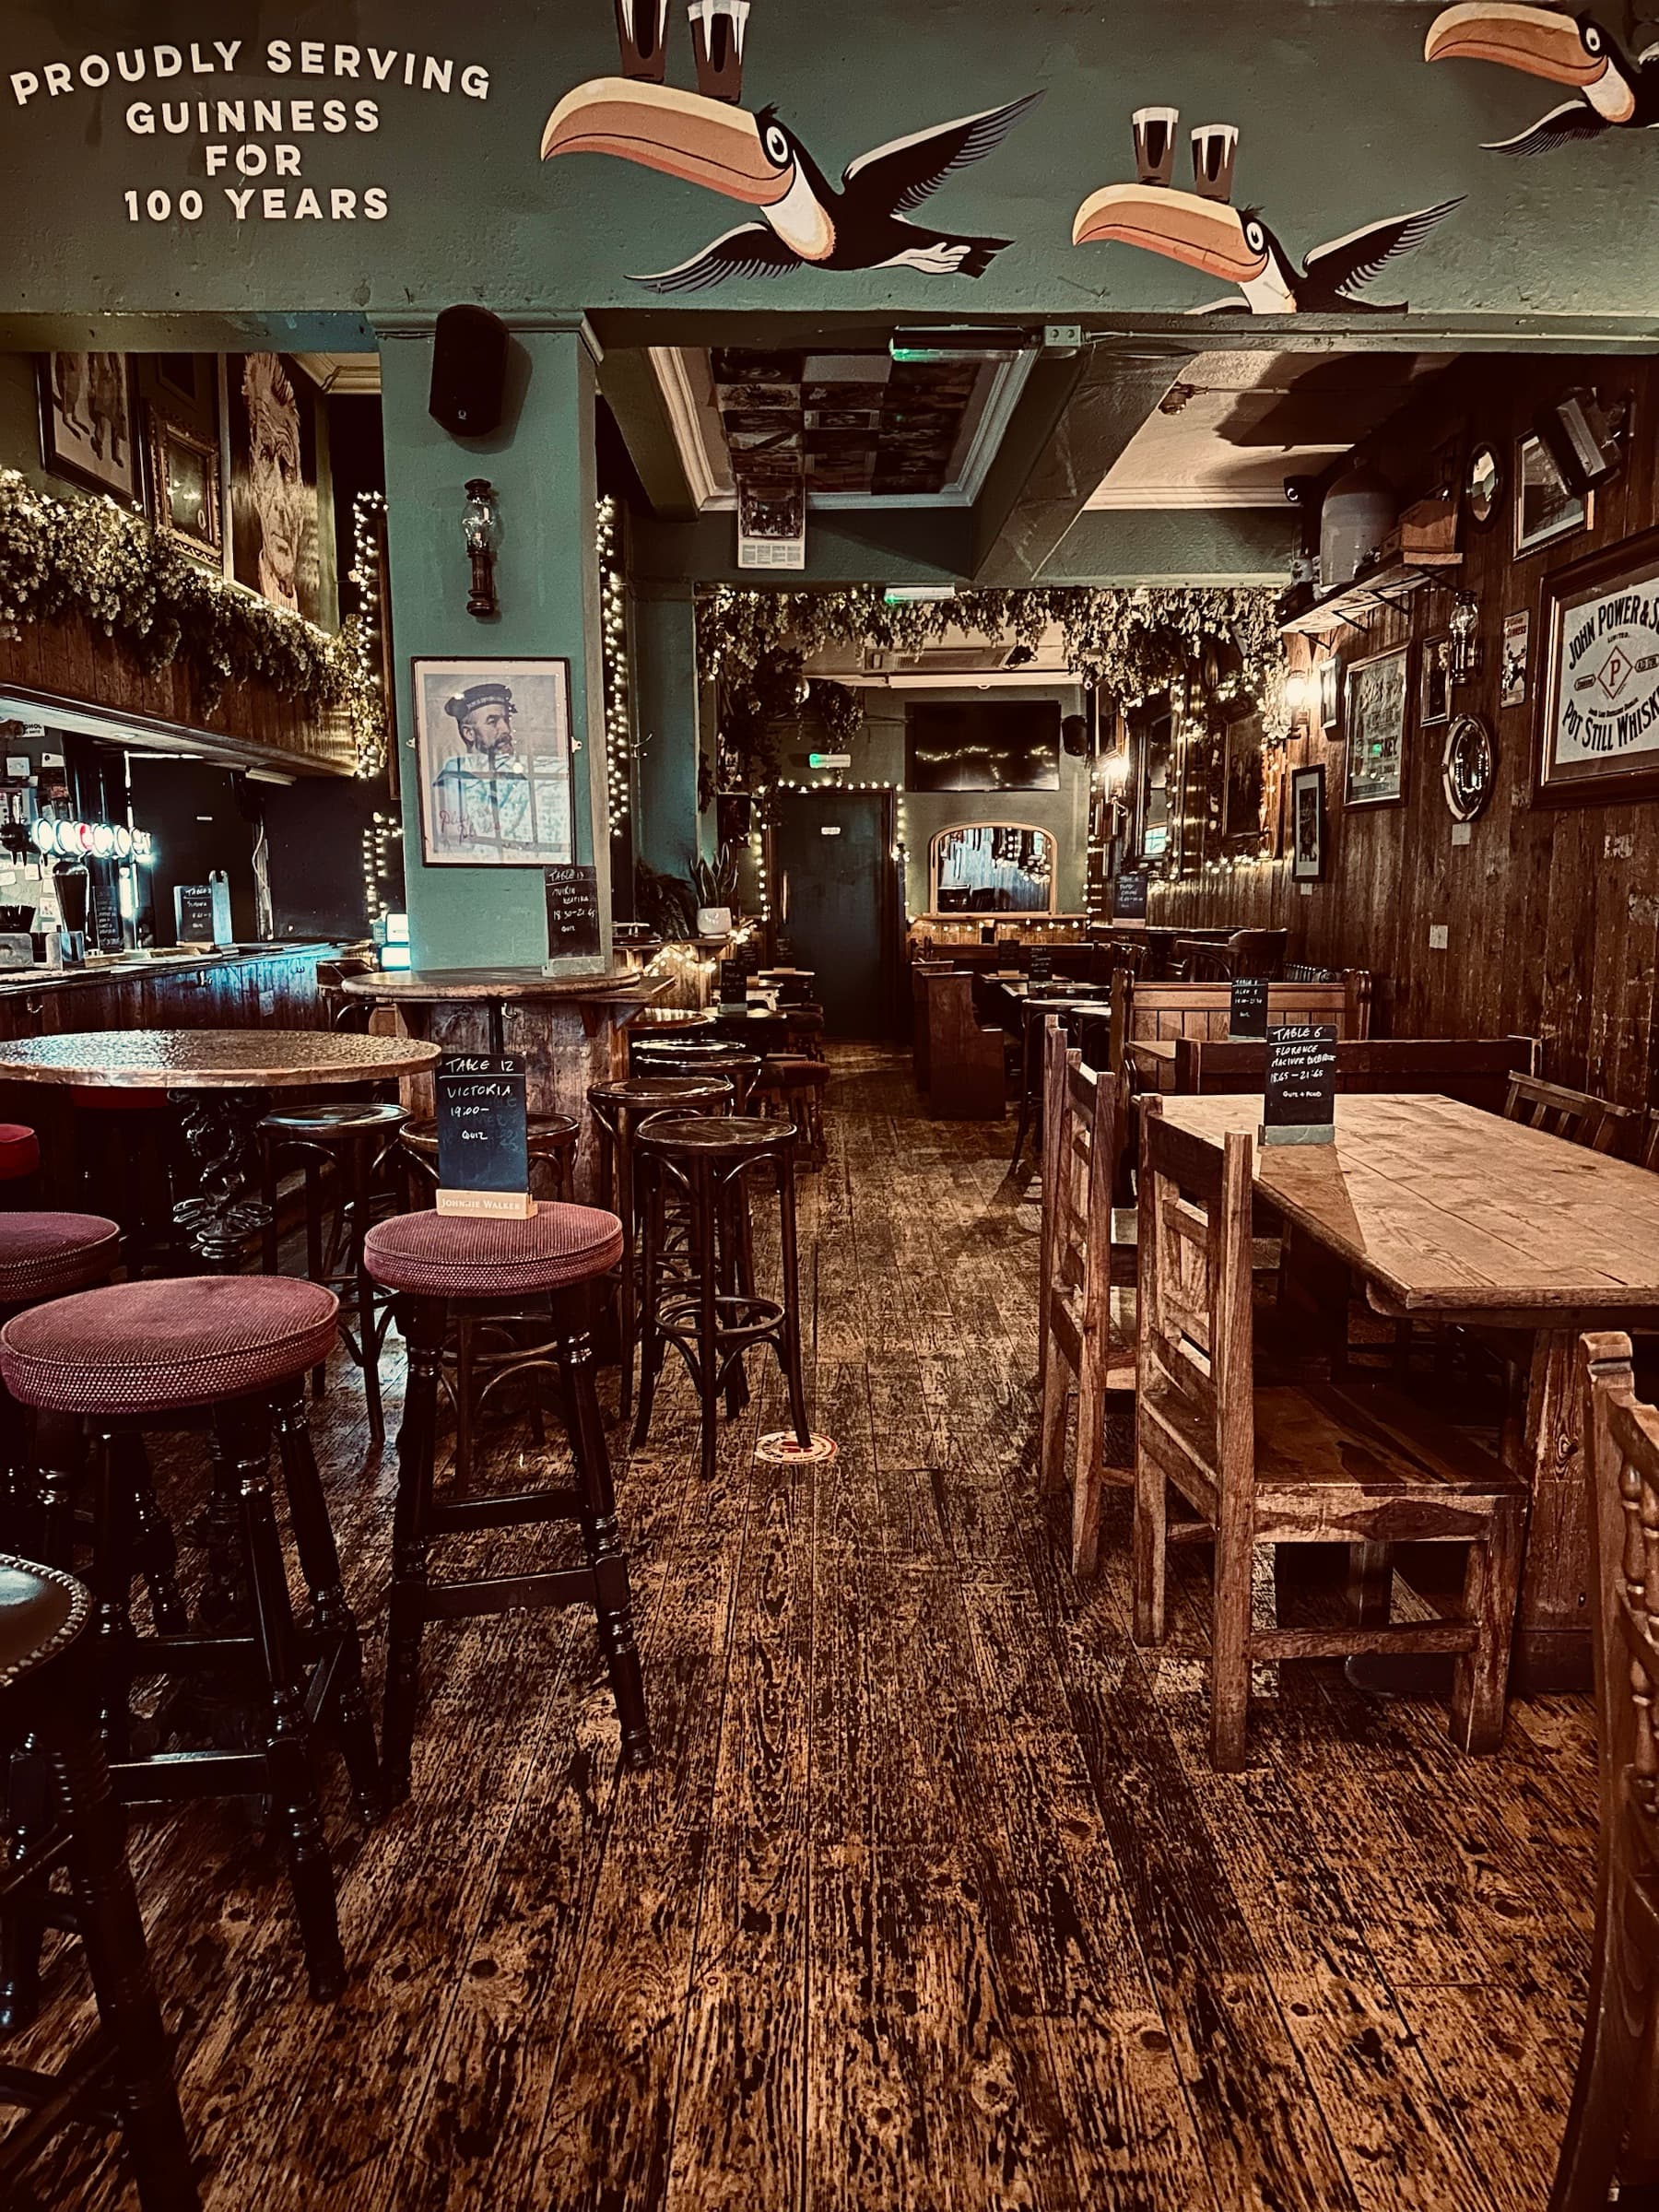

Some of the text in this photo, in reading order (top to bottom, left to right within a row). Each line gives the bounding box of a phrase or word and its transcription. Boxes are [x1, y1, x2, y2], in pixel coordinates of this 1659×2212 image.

[10, 40, 489, 106] PROUDLY SERVING
[126, 100, 379, 134] GUINNESS
[206, 144, 301, 176] FOR
[124, 188, 388, 221] 100 YEARS
[1569, 616, 1595, 670] JOHN
[1598, 595, 1641, 636] POWER
[1610, 659, 1621, 688] P
[1562, 699, 1583, 741] POT
[1583, 717, 1614, 751] STILL
[1617, 685, 1659, 747] WHISK
[1273, 1027, 1324, 1041] TABLE 6
[1276, 1044, 1319, 1056] FLORENCE
[446, 1058, 514, 1073] TABLE 12
[447, 1083, 512, 1099] VICTORIA
